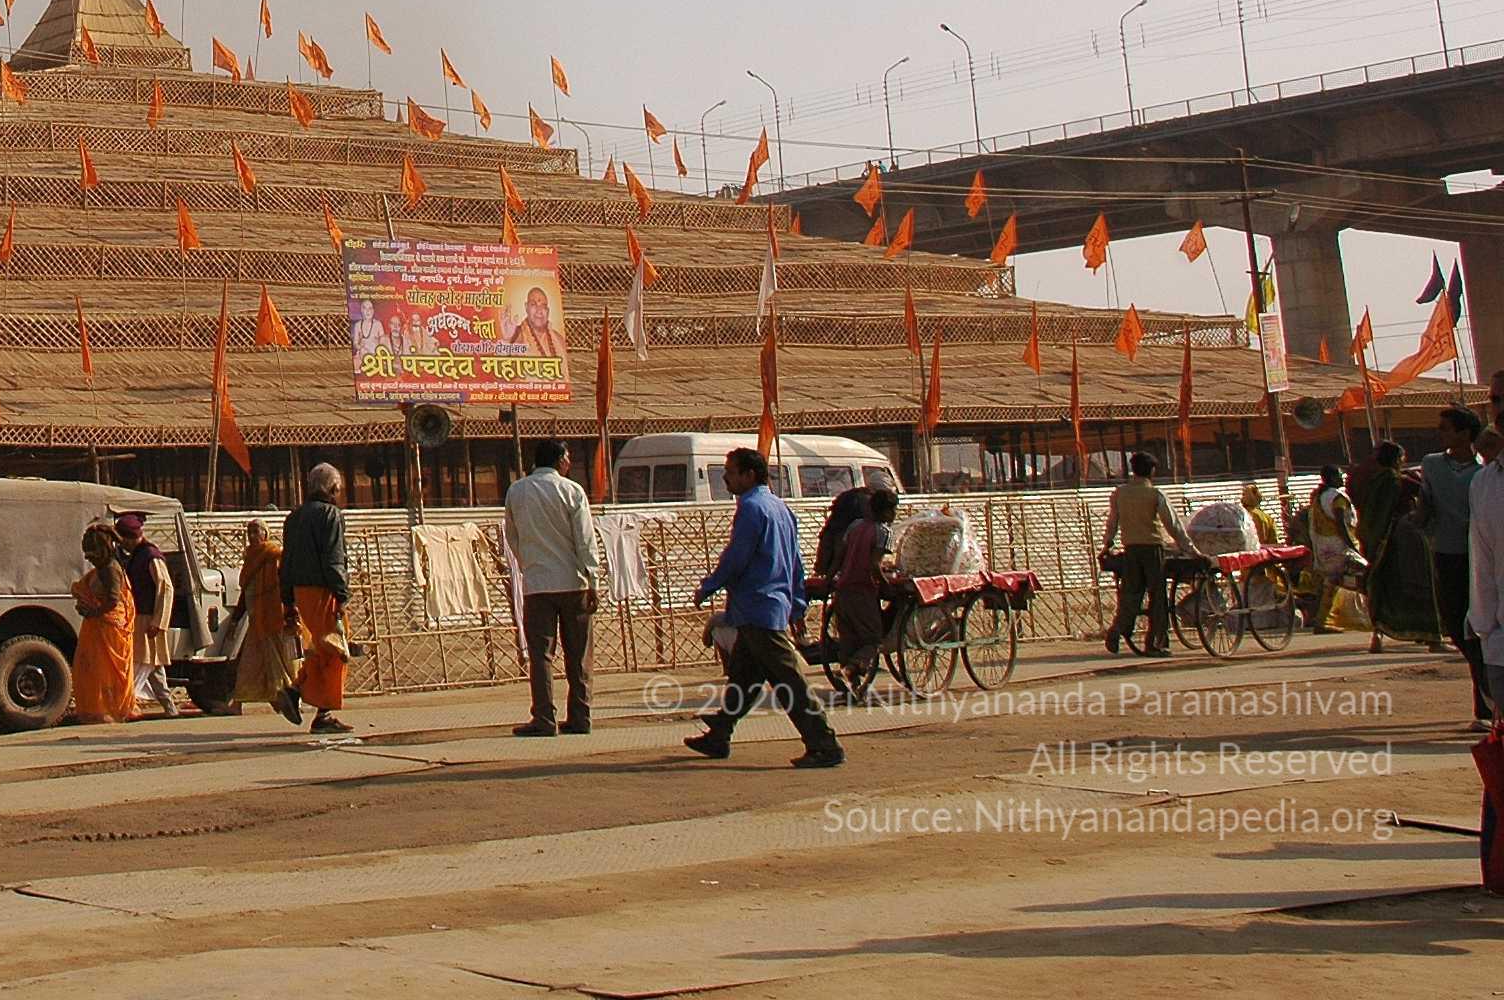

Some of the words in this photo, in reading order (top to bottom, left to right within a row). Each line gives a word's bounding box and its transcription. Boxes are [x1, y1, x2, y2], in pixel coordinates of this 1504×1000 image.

[473, 315, 496, 340] मेला
[361, 344, 395, 378] श्री
[400, 346, 476, 380] पंचदेव
[480, 355, 564, 380] महायज्ञ
